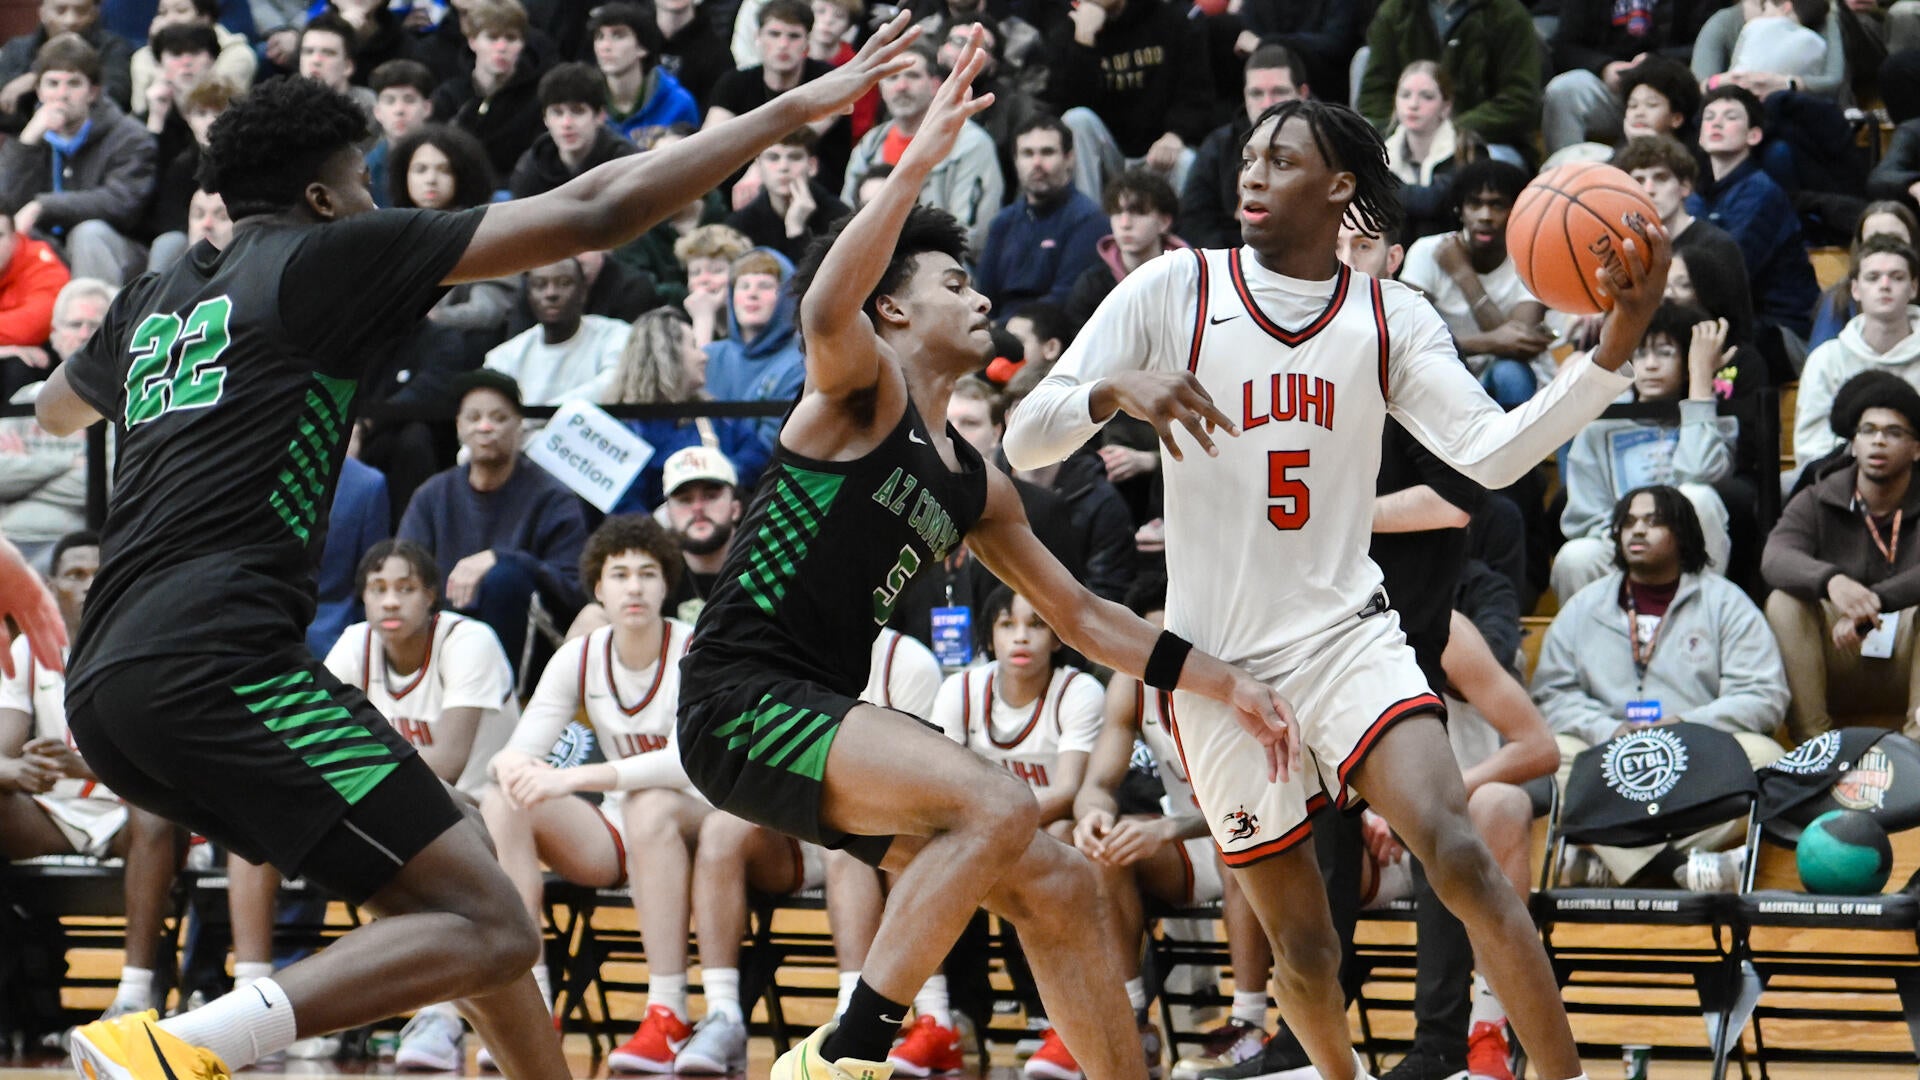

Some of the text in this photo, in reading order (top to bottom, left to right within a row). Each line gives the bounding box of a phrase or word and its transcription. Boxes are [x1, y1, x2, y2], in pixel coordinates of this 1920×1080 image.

[124, 294, 232, 431] 22
[1242, 373, 1335, 432] LUHI
[546, 433, 615, 491] Section
[566, 413, 629, 465] Parent
[871, 466, 918, 517] AZ
[1267, 448, 1311, 532] 5
[1615, 770, 1683, 802] SCHOLASTIC
[1621, 750, 1668, 773] EYBL
[1556, 899, 1680, 912] BASKETBALL HALL OF FAME
[1758, 901, 1883, 916] BASKETBALL HALL OF FAME
